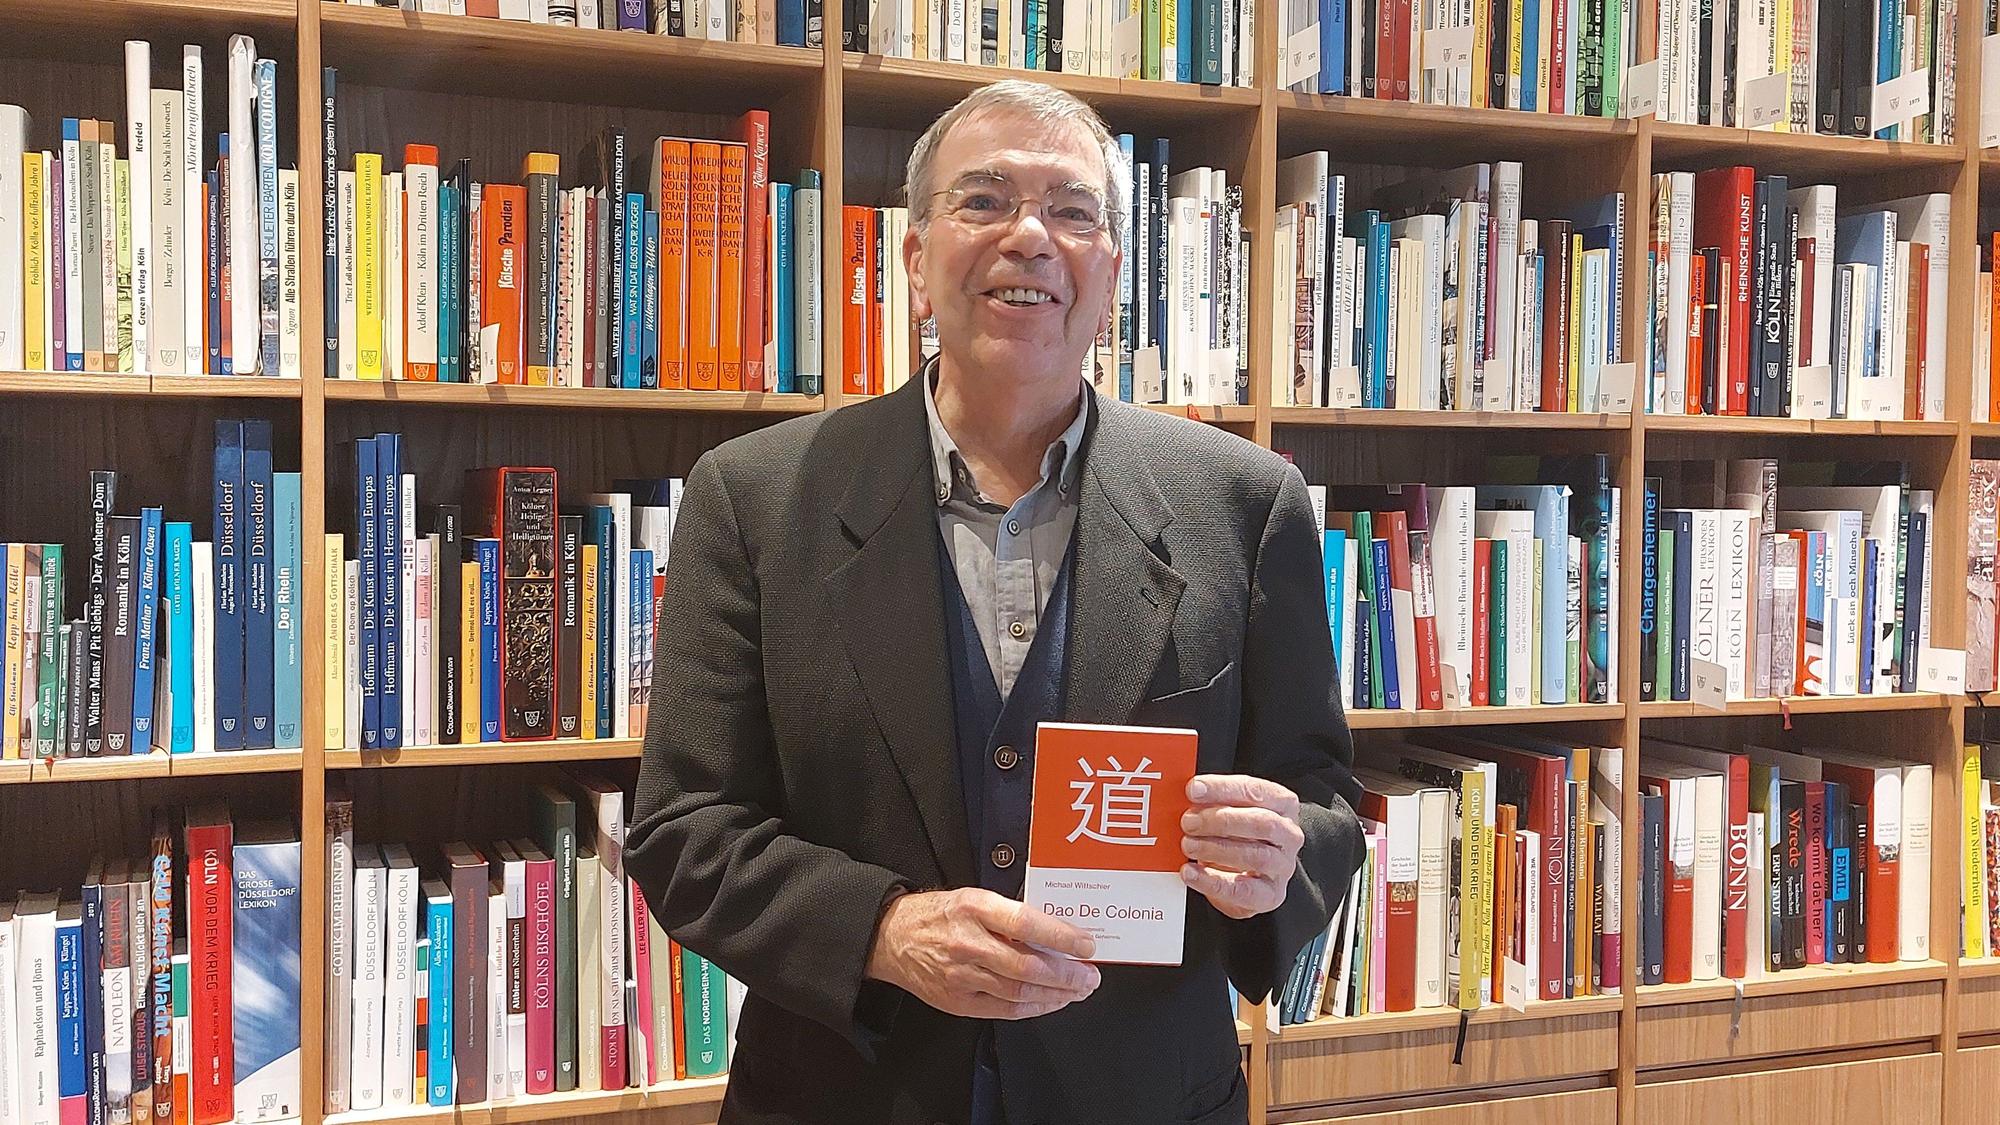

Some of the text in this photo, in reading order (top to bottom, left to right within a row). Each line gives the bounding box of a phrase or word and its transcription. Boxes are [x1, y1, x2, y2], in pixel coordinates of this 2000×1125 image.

[185, 65, 198, 173] Mönchengladbach
[325, 97, 335, 122] heute
[325, 124, 337, 155] gestern
[326, 157, 336, 188] damals
[135, 122, 147, 325] Greven Verlag Köln Krefeld
[284, 182, 297, 303] Alle Straßen führen durch Köln
[417, 173, 428, 333] Adolf Klein Köln im Dritten Reich
[498, 199, 516, 289] Kölsche Parodien
[850, 221, 864, 304] Kölsche Parodien
[1679, 218, 1685, 228] 2
[1739, 194, 1750, 301] RHEINISCHE KUNST
[1477, 317, 1485, 341] Kölner
[1765, 299, 1780, 343] KÖLN
[220, 481, 234, 557] Düsseldorf
[251, 481, 265, 557] Düsseldorf
[1849, 530, 1858, 574] Minsche
[1976, 477, 1997, 582] artifex
[115, 535, 130, 636] Romanik in Köln
[140, 527, 155, 670] Franz Mathar Kölner Oasen
[278, 567, 290, 629] Der Rhein
[329, 547, 339, 640] ANDREAS GOTTSCHALK
[364, 475, 376, 696] Hoffmann Die Kunst im Herzen Europas
[383, 474, 396, 694] Hoffmann Die Kunst im Herzen Europas
[564, 533, 576, 626] Romanik in Köln
[1457, 500, 1468, 650] Rheinische Bräuche durch das Jahr
[1641, 489, 1657, 634] Chargesheimer
[1728, 520, 1743, 659] KÖLN LEXIKON
[1814, 553, 1824, 586] KÖLN
[89, 482, 105, 726] Walter Maas Pit Siebigs Der Aachener Dom
[1848, 619, 1856, 644] Lück
[1065, 755, 1163, 846] 道
[1484, 828, 1493, 848] heute
[1789, 808, 1801, 868] Wrede
[238, 871, 256, 879] DAS
[1470, 788, 1480, 899] KÖLN UND DER KRIEG
[1484, 850, 1494, 876] gestern
[1549, 836, 1563, 885] KÖLN
[1729, 823, 1748, 911] BONN
[1812, 803, 1823, 939] Wo kommt dat her?
[1836, 855, 1847, 894] EMIL
[1971, 817, 1981, 906] Am Niederrhein
[204, 849, 219, 990] KÖLN VOR DEM KRIEG
[238, 880, 274, 888] GROSSE
[238, 888, 296, 898] DÜSSELDORF
[238, 900, 276, 908] LEXIKON
[333, 836, 344, 976] GOTIK IM RHEINLAND
[1043, 902, 1164, 921] Dao De Colonia
[1045, 881, 1111, 890] Michael Wittschier
[1483, 878, 1492, 905] damals
[1483, 907, 1491, 926] Köln
[1772, 854, 1781, 917] ERFTSTADT
[364, 874, 378, 981] DÜSSELDORF KÖLN
[395, 874, 408, 980] DÜSSELDORF KÖLN
[512, 923, 521, 1009] Altbier am Niederrhein
[534, 881, 550, 1009] KÖLNS BISCHÖFE
[1482, 956, 1491, 975] Peter
[34, 985, 44, 1002] und
[110, 900, 123, 1047] NAPOLEON AM RHEIN
[136, 917, 147, 1080] LUISE STRAUS Eine Frau blickt sich
[34, 1005, 46, 1057] Raphaelson
[608, 1029, 618, 1067] IN KÖLN
[703, 1026, 711, 1044] DAS
